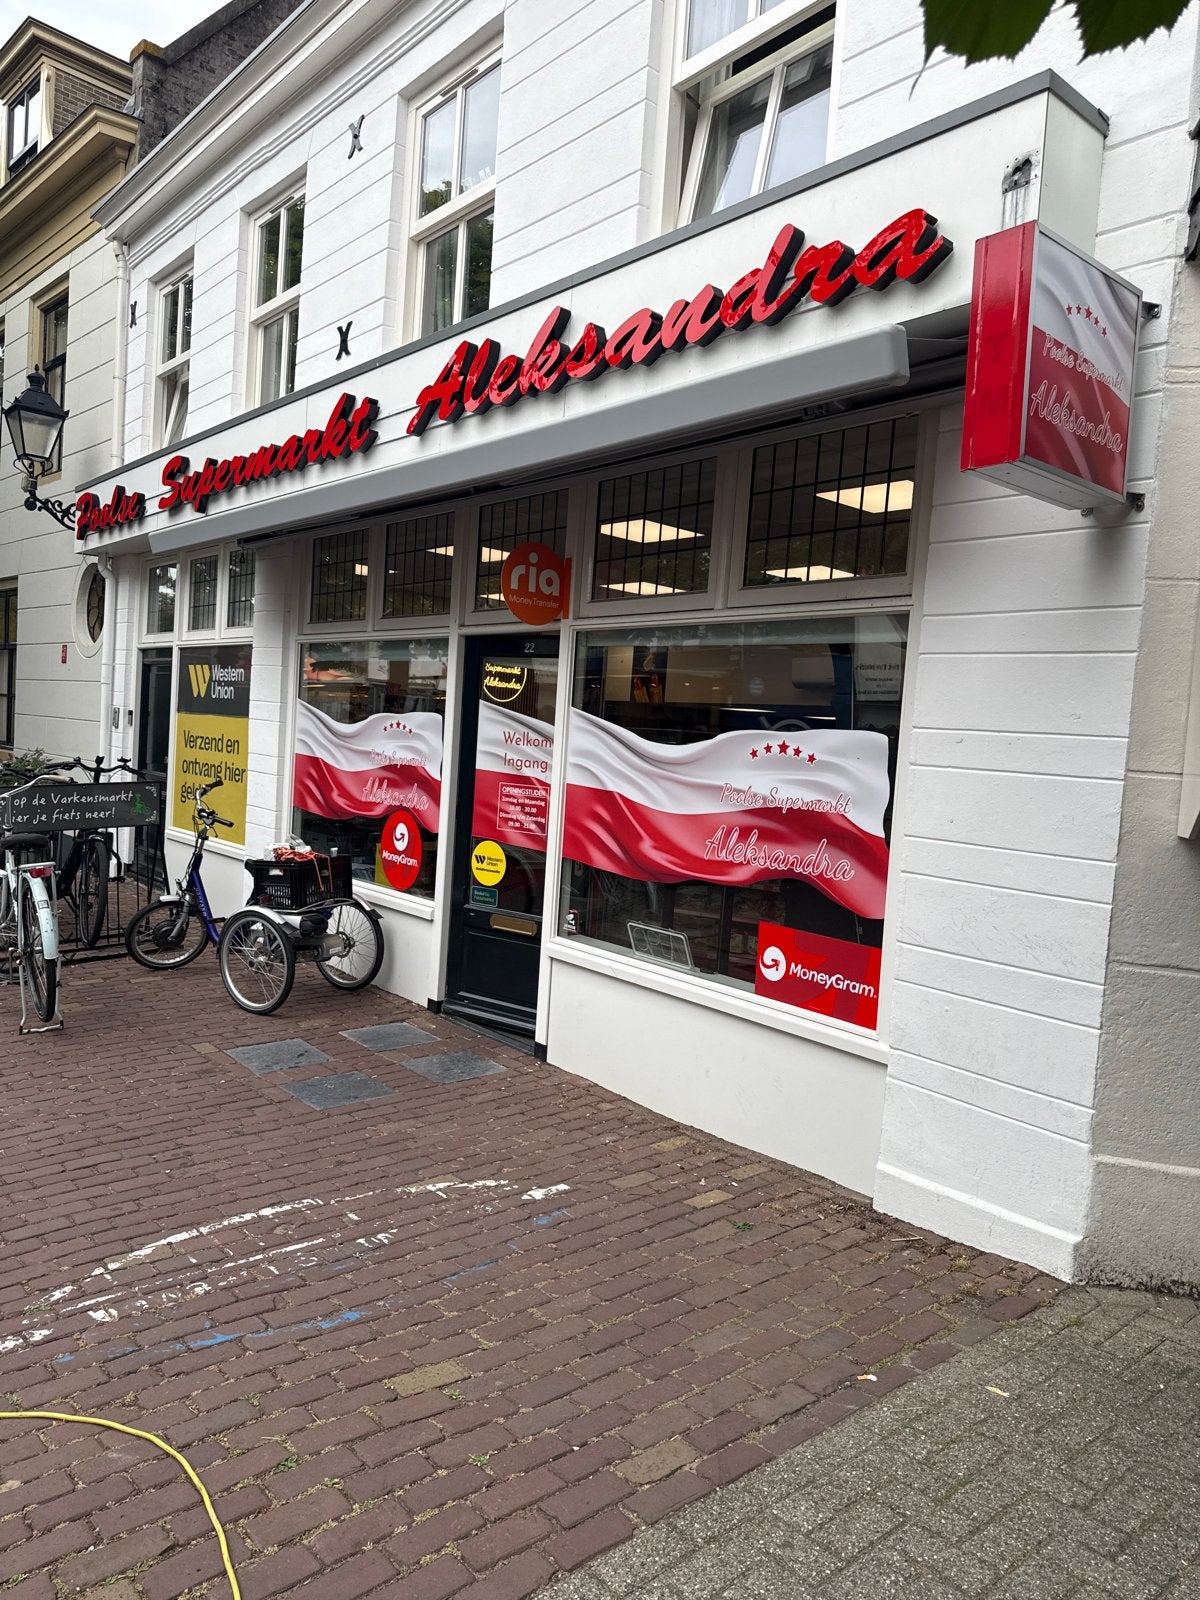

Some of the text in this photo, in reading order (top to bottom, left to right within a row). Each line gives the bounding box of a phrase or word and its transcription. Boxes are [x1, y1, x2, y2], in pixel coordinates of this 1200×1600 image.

[1042, 333, 1075, 369] Poolse
[75, 484, 146, 540] Poolse
[158, 392, 379, 514] Supermarkt
[406, 207, 954, 437] Aleksandra
[1030, 379, 1123, 453] Aleksandra
[510, 551, 561, 597] ria
[508, 594, 560, 609] Money Transfer
[524, 642, 535, 653] 22
[211, 664, 245, 682] Western
[484, 662, 521, 676] Supermarkt
[211, 682, 235, 700] Union
[483, 676, 522, 690] Aleksandra
[183, 730, 240, 755] Verzend en
[502, 730, 552, 748] Welkom
[182, 758, 246, 784] ontvang hier
[503, 752, 549, 774] Ingang
[14, 796, 27, 808] op
[32, 793, 47, 806] de
[51, 790, 134, 805] Varkensmarkt
[362, 777, 429, 811] Aleksandra
[719, 782, 853, 815] Poolse Supermarkt
[12, 807, 116, 825] ier je fiets neer!
[704, 824, 855, 881] Aleksandra
